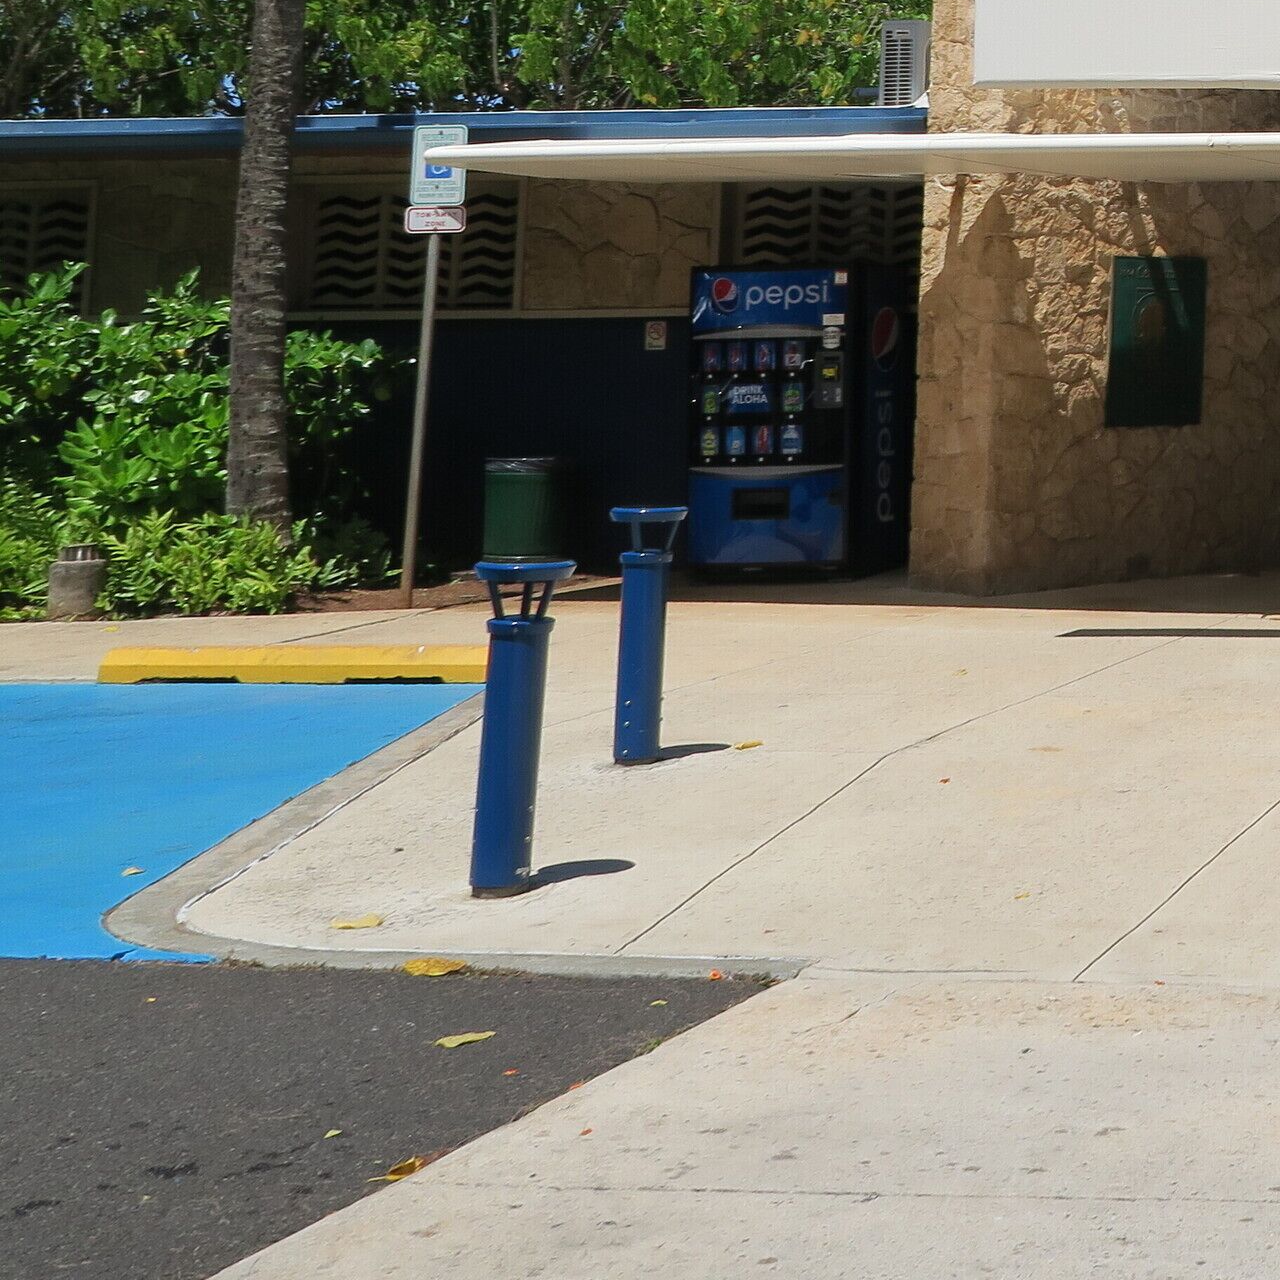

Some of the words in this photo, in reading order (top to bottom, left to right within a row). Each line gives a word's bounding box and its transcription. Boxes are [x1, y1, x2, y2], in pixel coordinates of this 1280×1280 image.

[745, 280, 828, 311] pepsi
[731, 394, 768, 405] ALOHA
[733, 384, 764, 394] DRINK
[875, 390, 896, 523] pepsi
